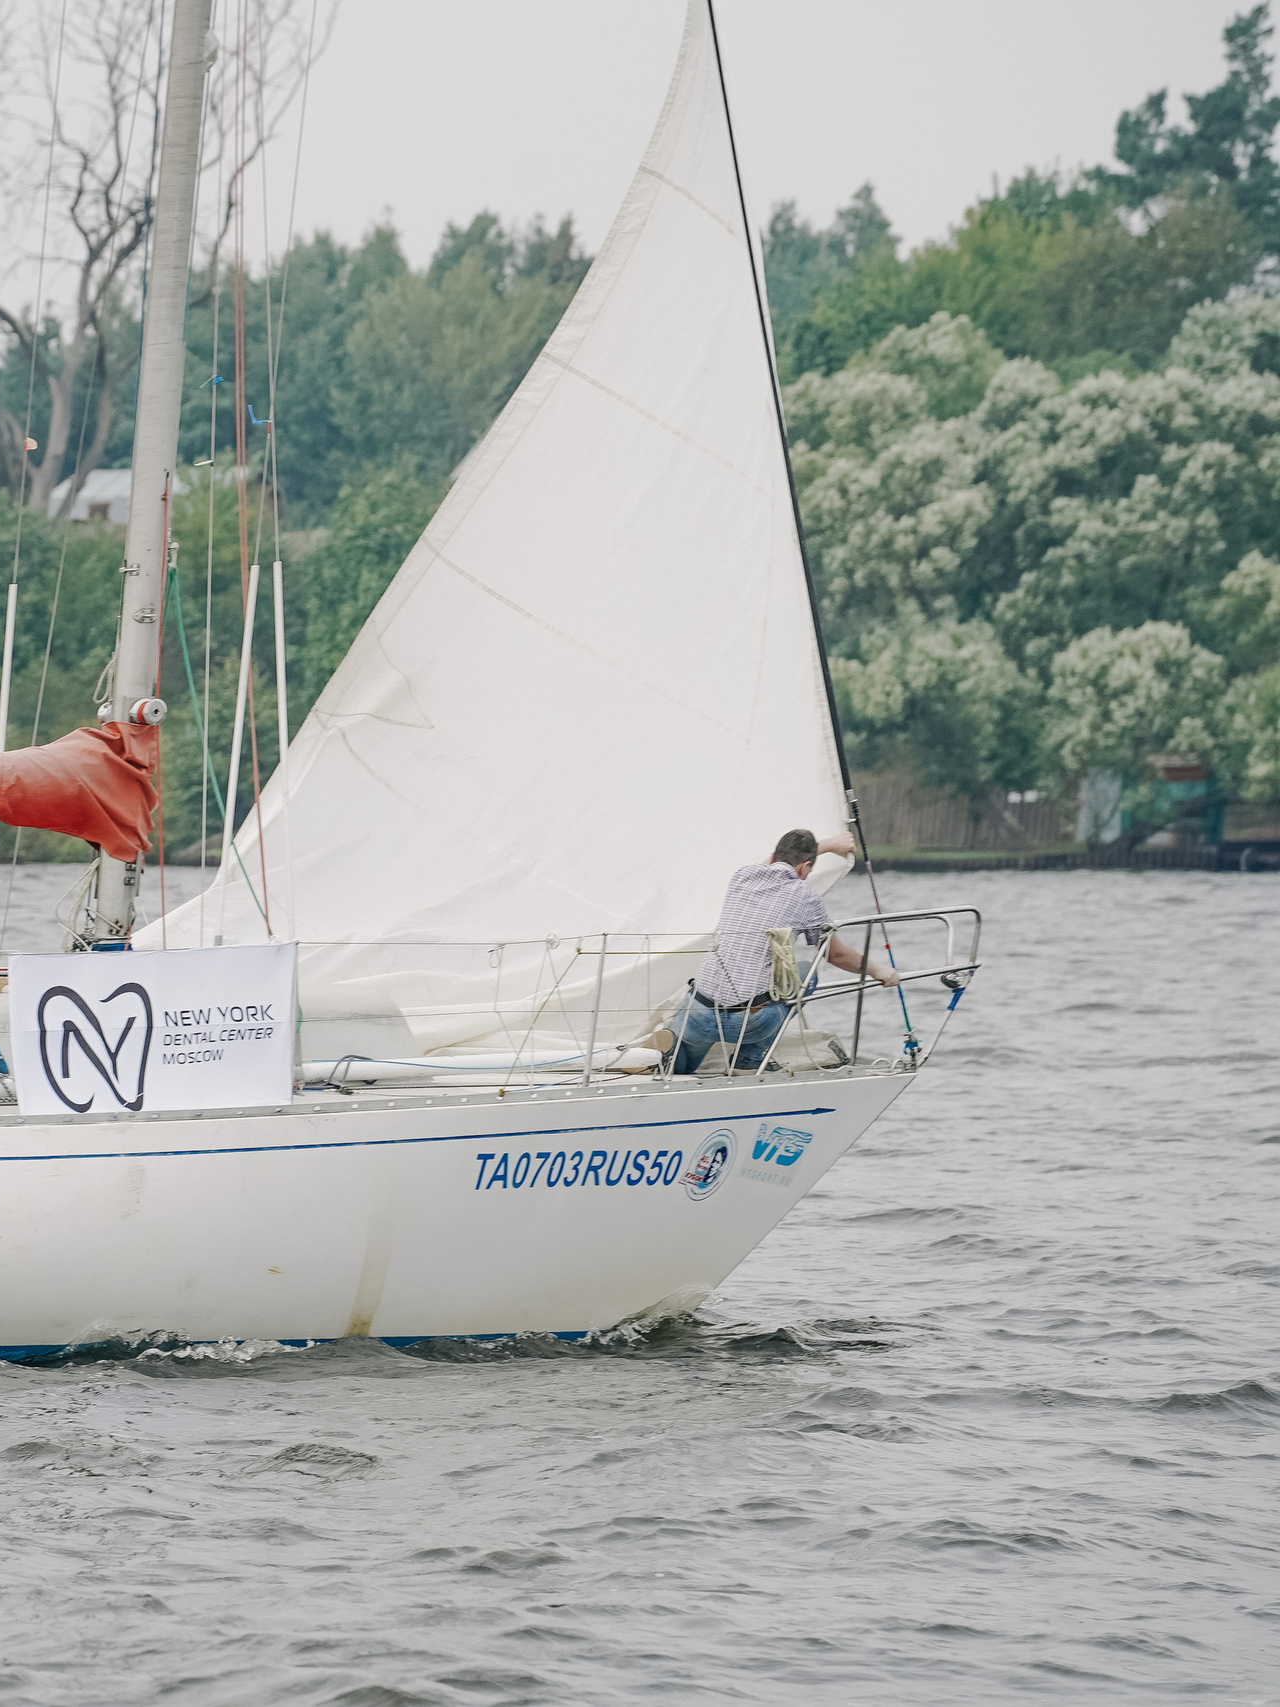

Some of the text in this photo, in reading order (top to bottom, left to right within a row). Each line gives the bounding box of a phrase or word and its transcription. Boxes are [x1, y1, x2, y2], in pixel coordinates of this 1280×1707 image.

[164, 1004, 275, 1027] NEW YORK
[163, 1027, 274, 1046] DENTAL CENTER
[162, 1048, 225, 1065] MOSCOW
[475, 1150, 683, 1190] TA0703RUS50
